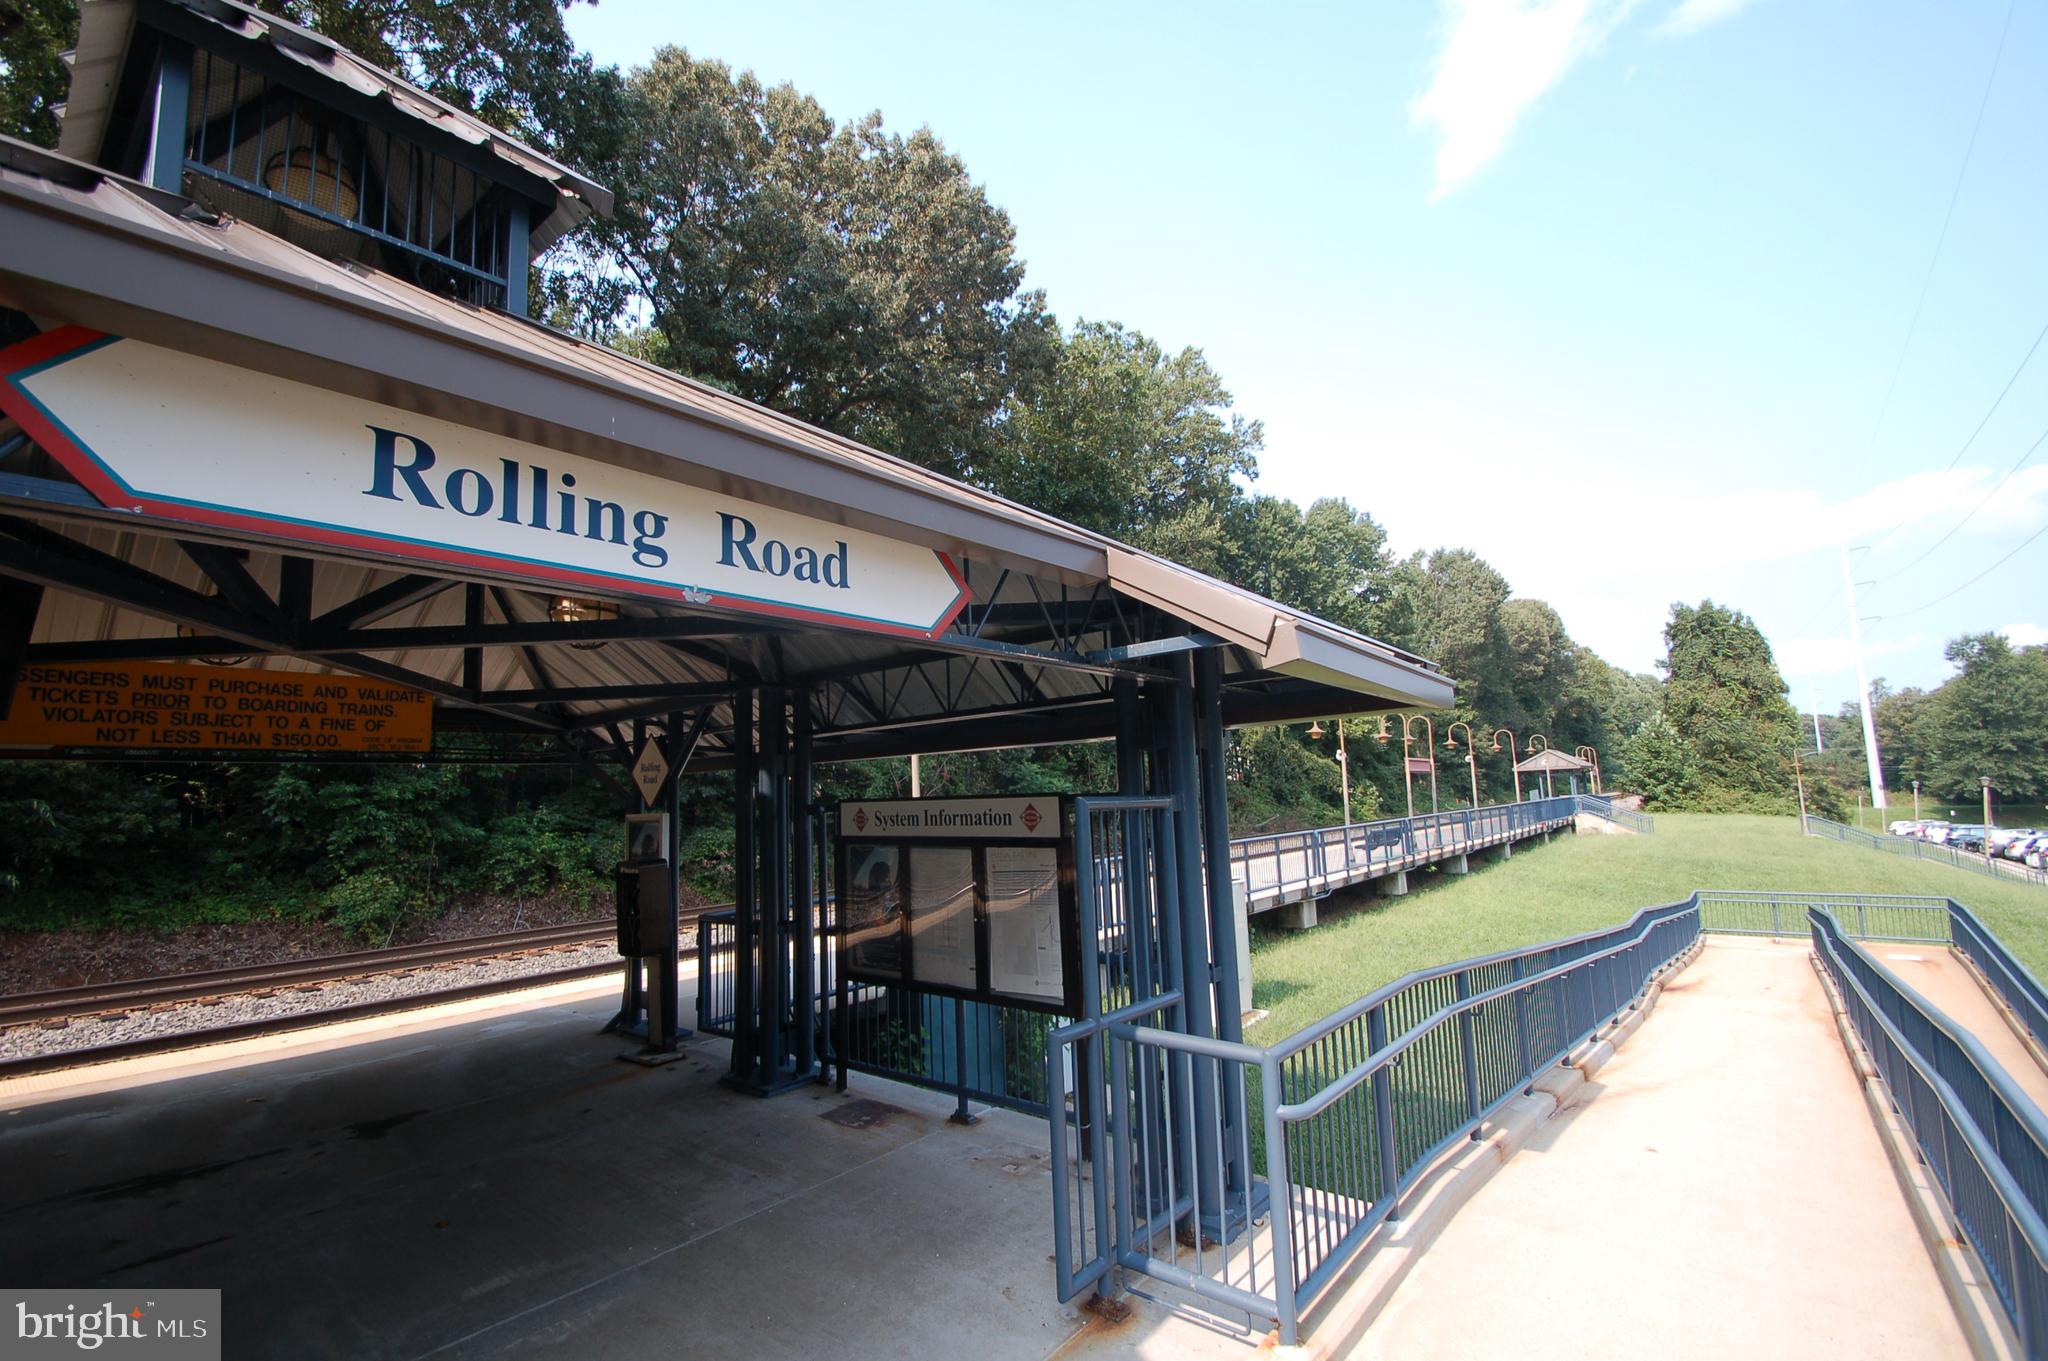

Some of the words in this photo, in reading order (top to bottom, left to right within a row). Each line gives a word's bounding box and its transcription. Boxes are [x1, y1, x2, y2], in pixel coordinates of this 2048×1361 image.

[361, 424, 669, 569] Rolling
[715, 510, 851, 590] Road
[142, 674, 198, 692] MUST
[208, 678, 304, 698] PURCHASE
[313, 686, 348, 700] AND
[357, 687, 425, 703] VALIDATE
[28, 686, 119, 706] TICKETS
[131, 691, 190, 708] PRIOR
[202, 695, 226, 710] TO
[238, 697, 327, 714] BOARDING
[338, 702, 397, 718] TRAINS.
[42, 706, 159, 726] VIOLATORS
[171, 711, 255, 729] SUBJECT
[266, 717, 289, 730] TO
[298, 717, 310, 730] A
[320, 718, 356, 731] FINE
[364, 719, 386, 732] OF
[96, 727, 138, 743] NOT
[151, 730, 200, 745] LESS
[213, 731, 261, 746] THAN
[643, 774, 658, 785] Road
[874, 810, 919, 832] System
[924, 808, 1012, 827] Information
